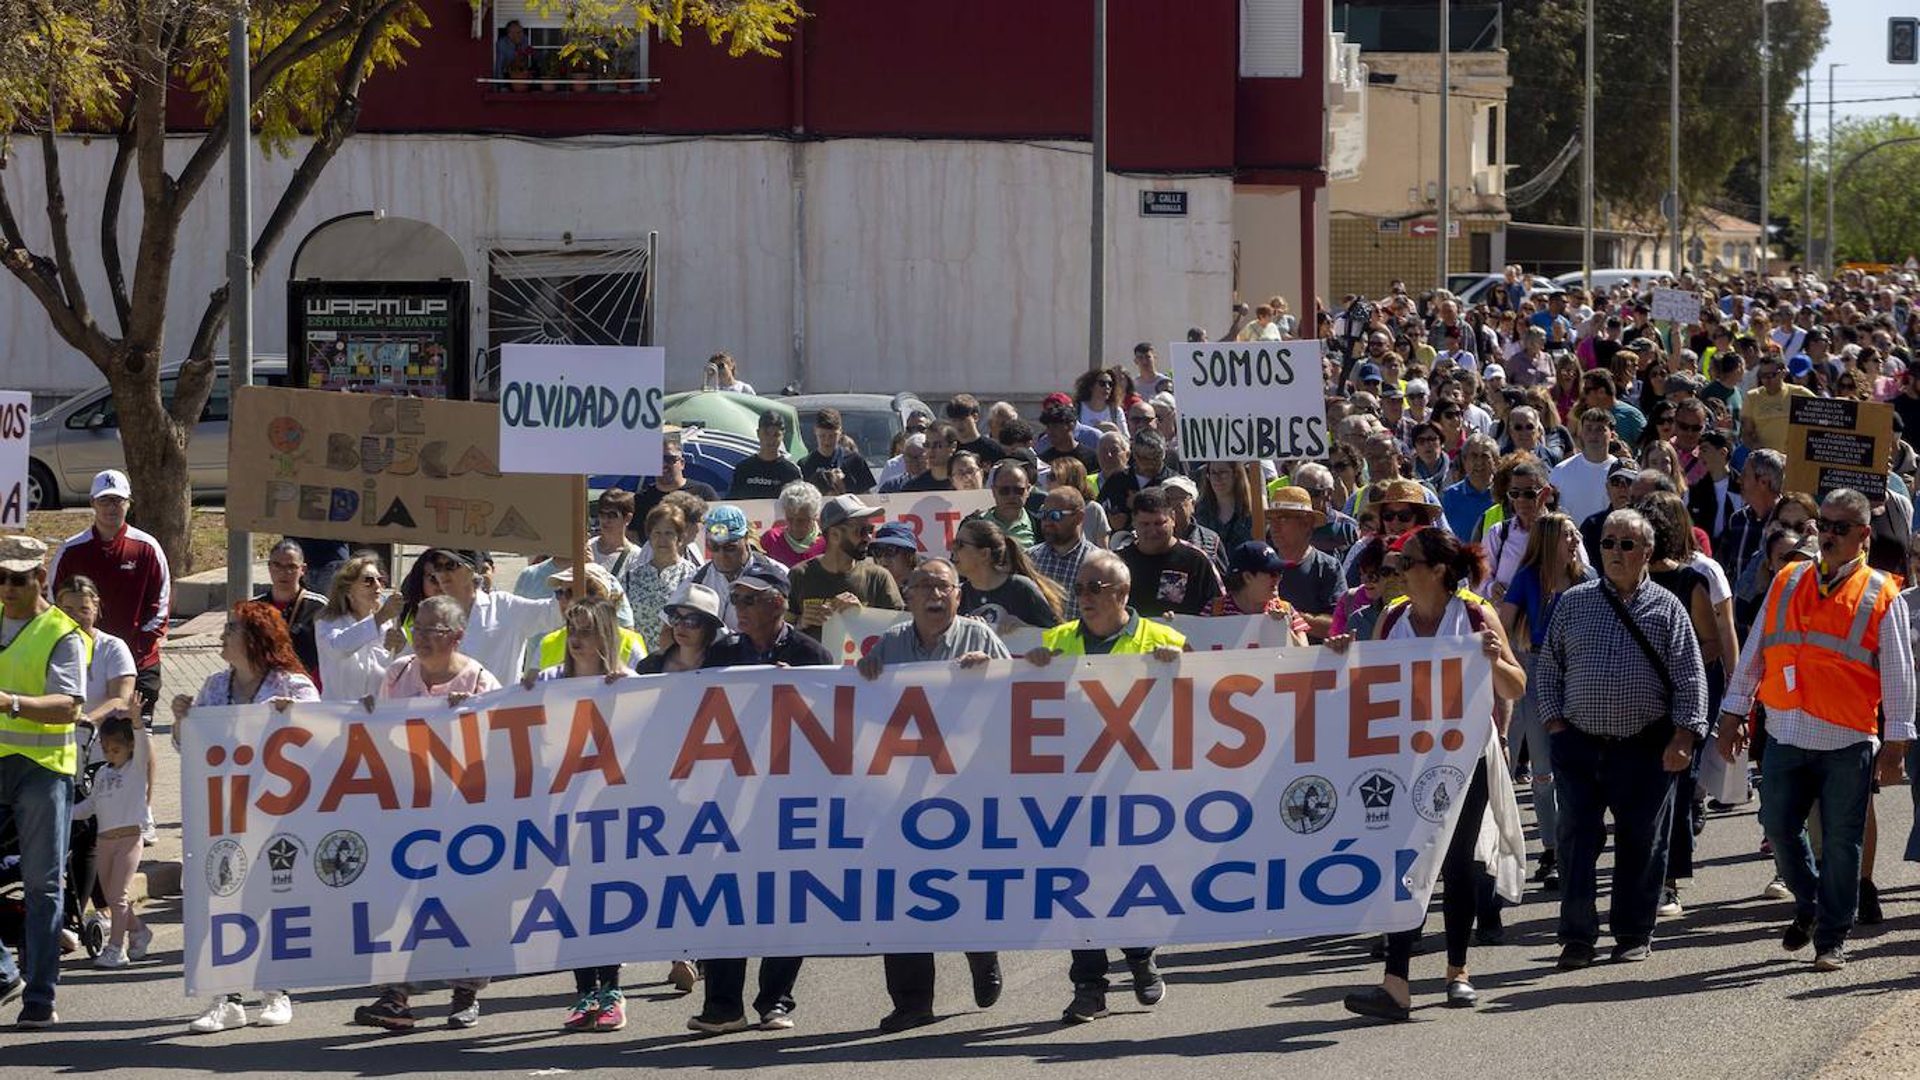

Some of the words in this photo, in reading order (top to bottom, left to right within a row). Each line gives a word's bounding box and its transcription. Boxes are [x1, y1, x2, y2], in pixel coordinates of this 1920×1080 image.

[307, 300, 401, 315] WARM
[405, 300, 447, 315] UP
[307, 317, 375, 327] ESTRELLA
[386, 317, 447, 327] LEVANTE
[1192, 349, 1294, 387] SOMOS
[369, 398, 425, 434] SE
[327, 432, 502, 479] BUSCA
[670, 686, 957, 777] ANA
[1010, 657, 1464, 776] EXISTE!!
[392, 798, 740, 882] CONTRA
[776, 794, 865, 852] EL
[897, 790, 1255, 857] OLVIDO
[211, 905, 313, 966] DE
[352, 896, 470, 953] LA
